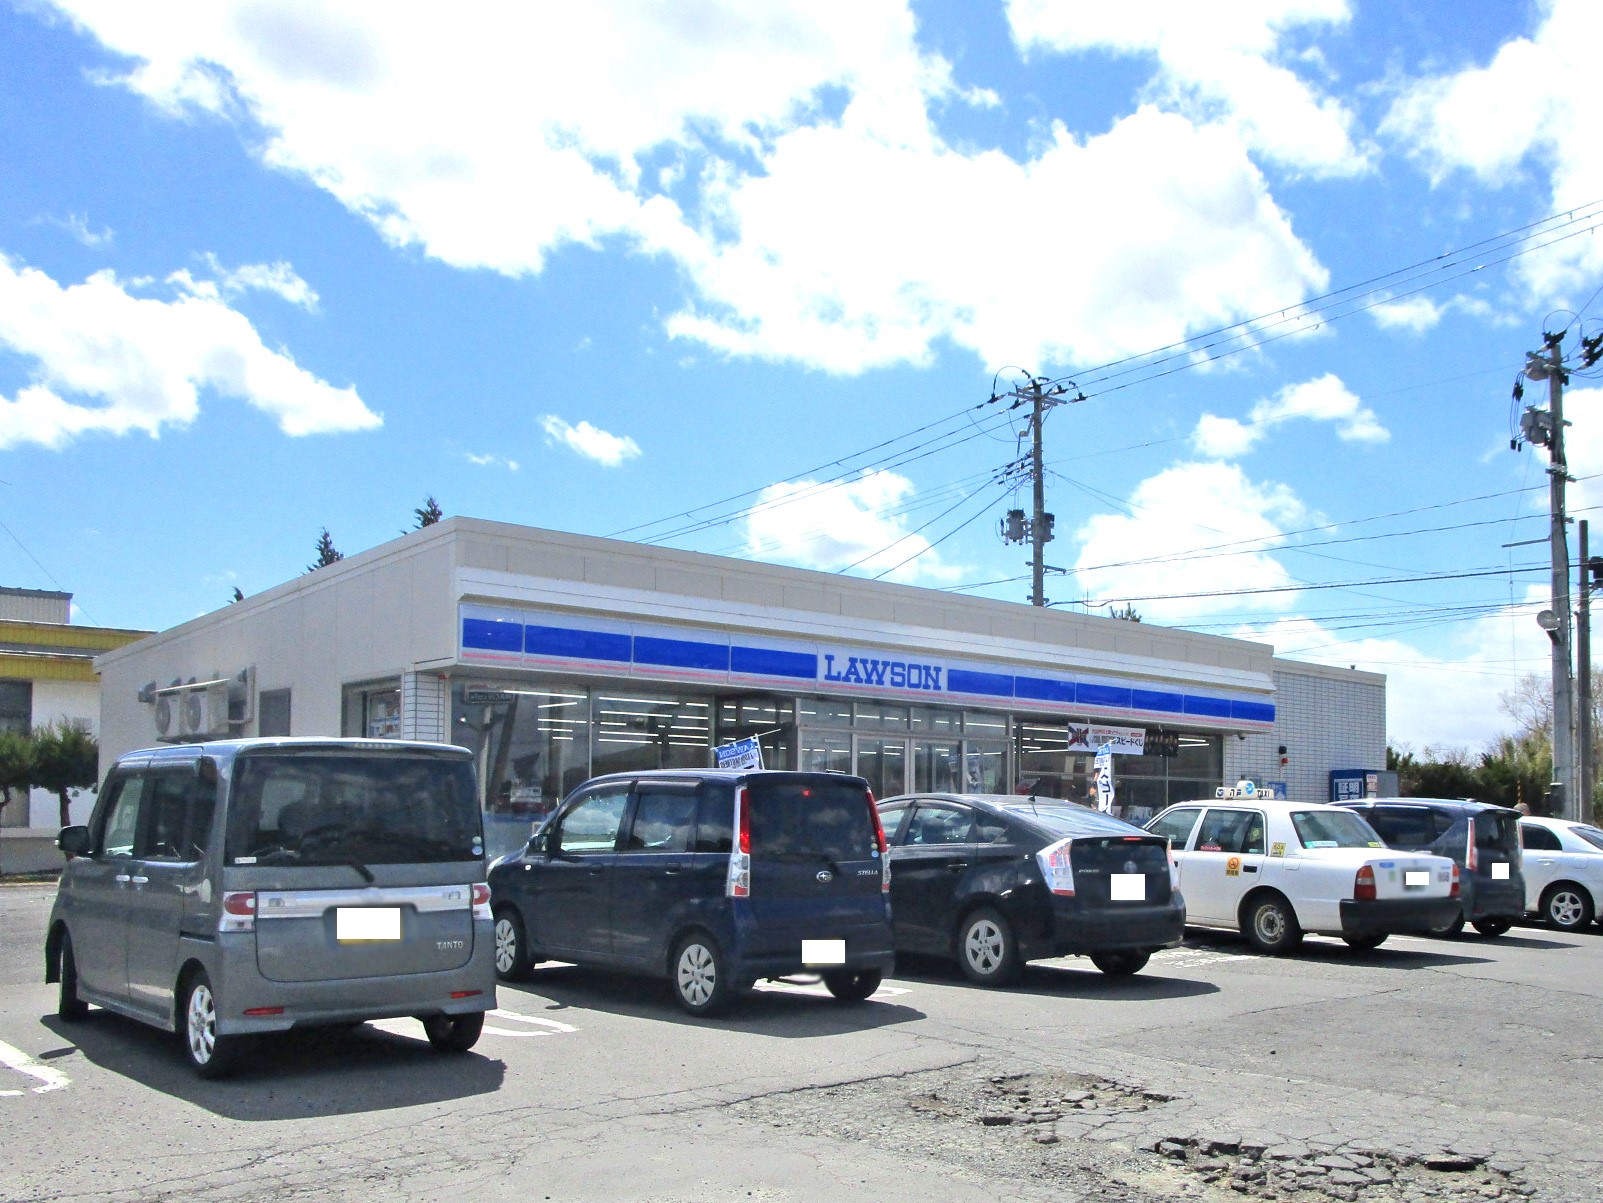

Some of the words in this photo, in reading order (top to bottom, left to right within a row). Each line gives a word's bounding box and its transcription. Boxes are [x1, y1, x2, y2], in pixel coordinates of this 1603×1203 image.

[824, 654, 942, 690] LAWSON
[1256, 790, 1270, 798] TAXI
[436, 941, 463, 950] TANTO
